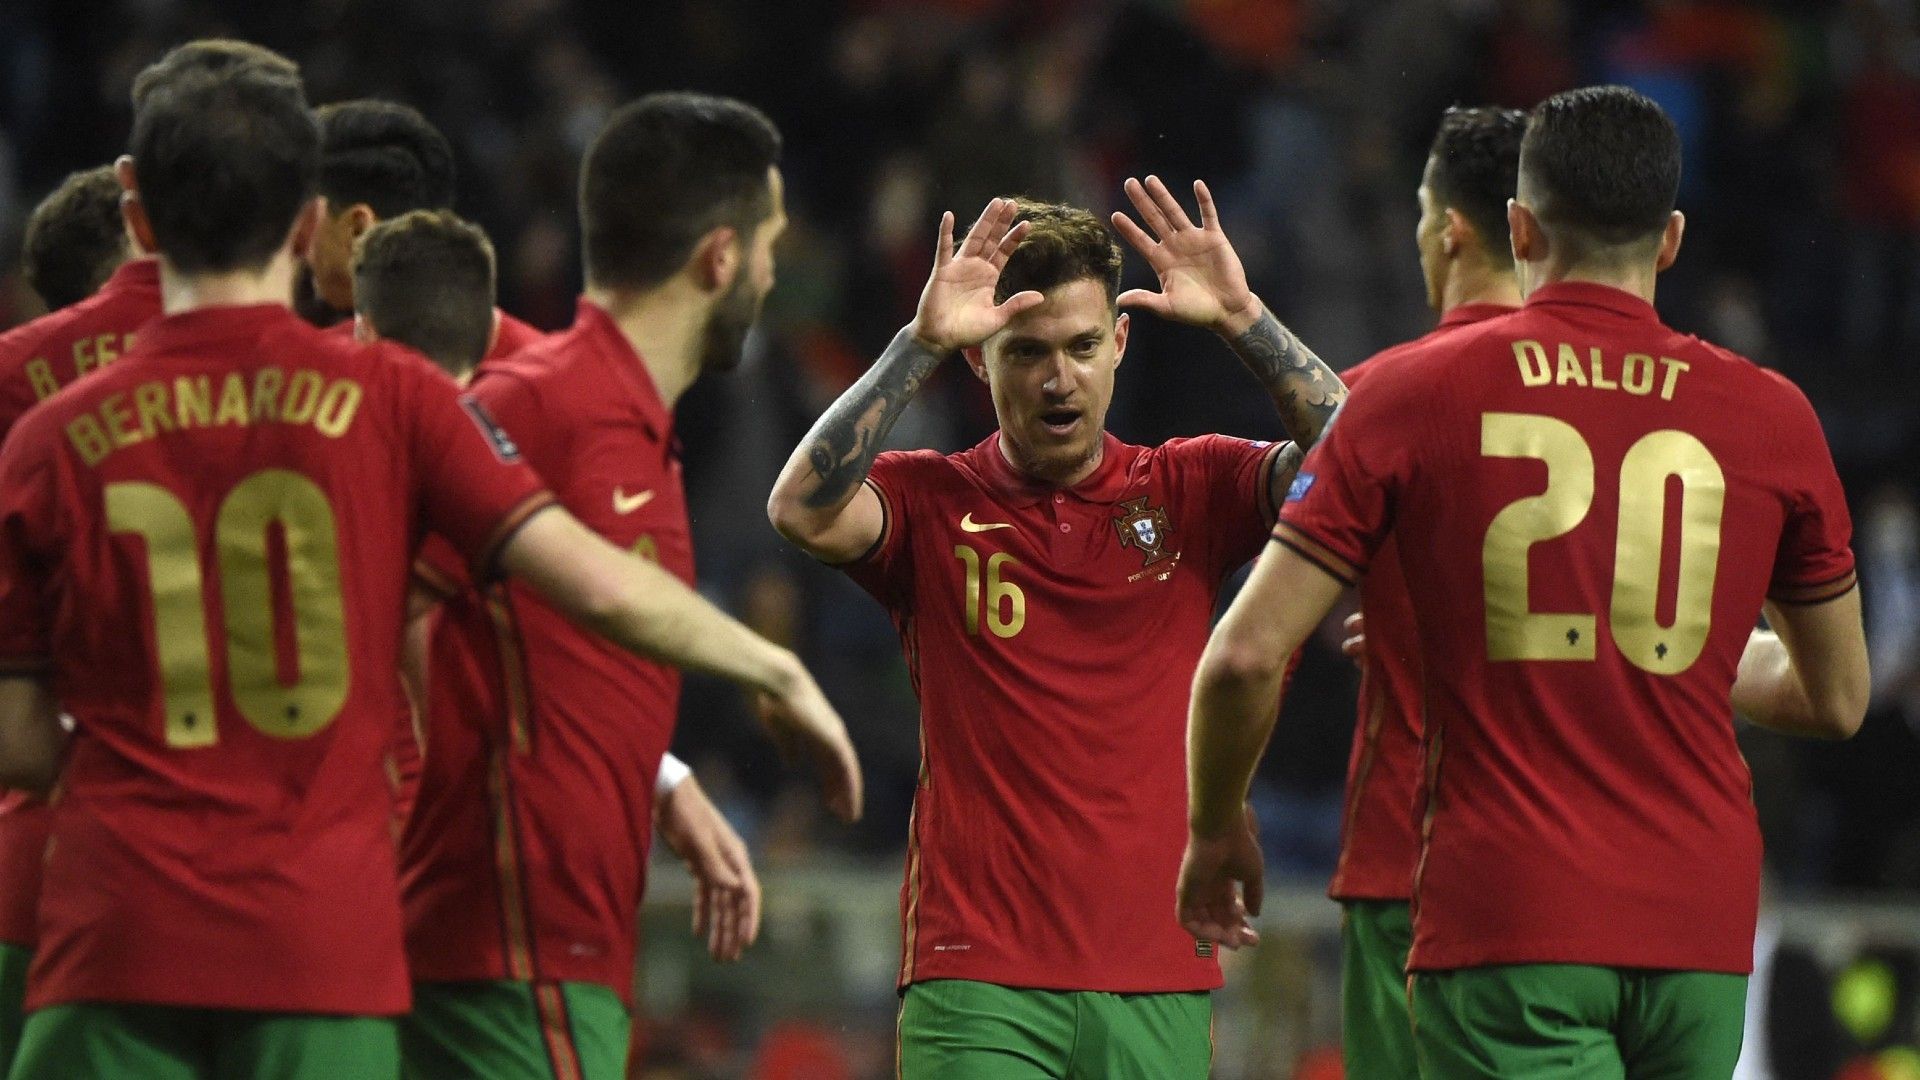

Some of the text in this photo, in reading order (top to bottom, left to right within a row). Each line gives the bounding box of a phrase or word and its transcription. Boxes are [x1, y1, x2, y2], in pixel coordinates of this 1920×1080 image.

[67, 366, 363, 466] BERNARDO
[1512, 339, 1690, 401] DALOT
[955, 545, 1026, 638] 16
[1480, 411, 1726, 676] 20
[103, 469, 350, 748] 10
